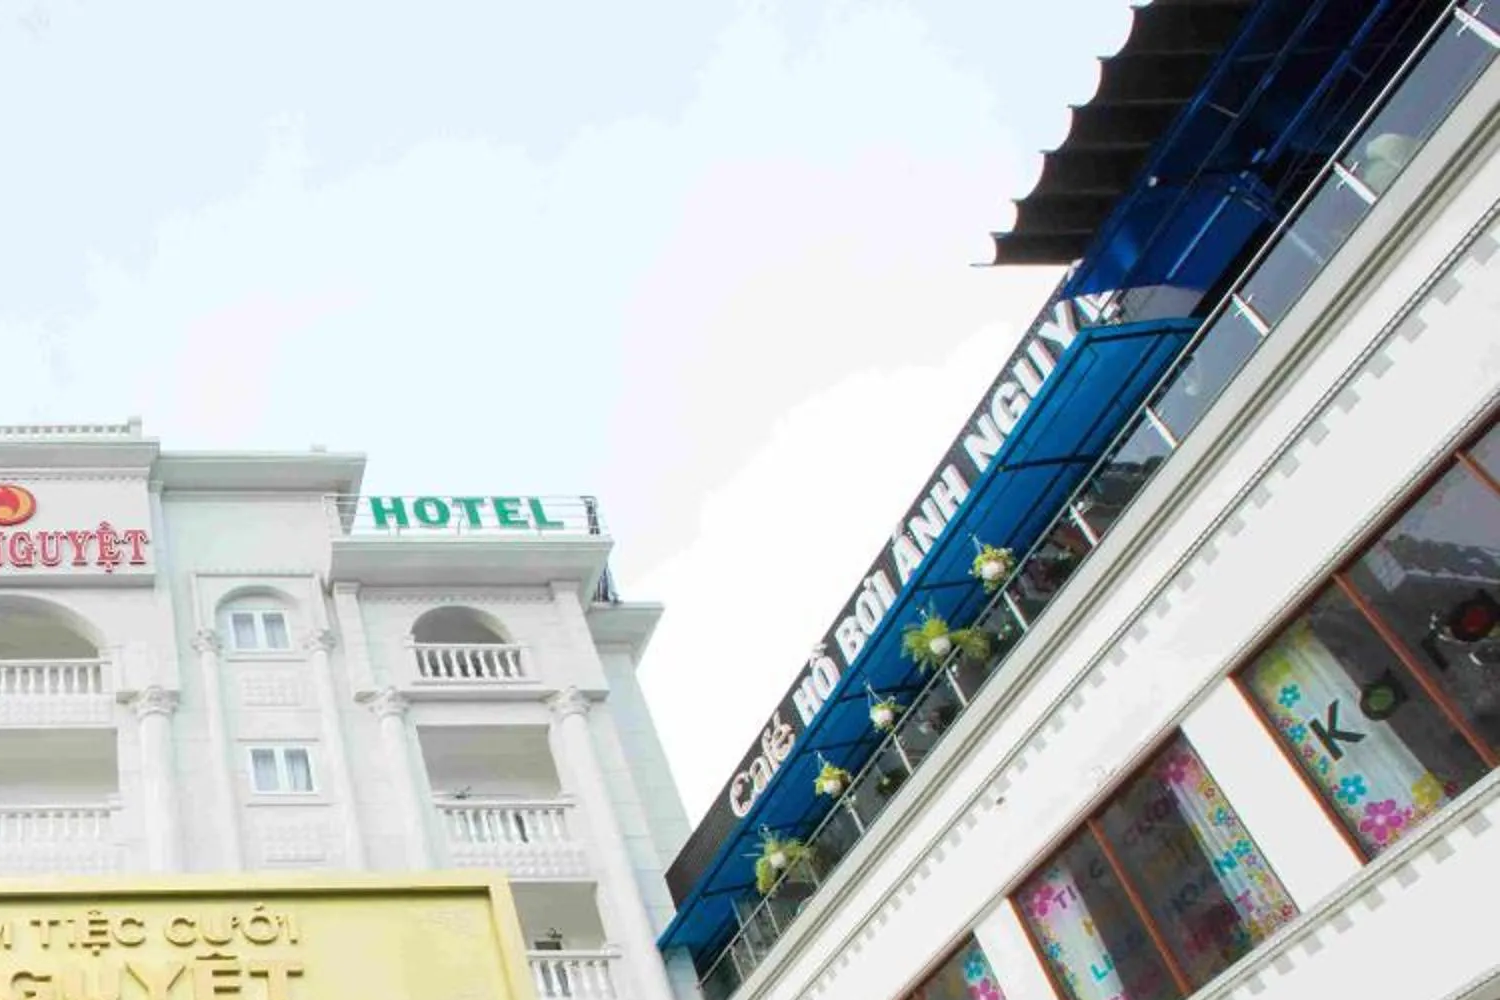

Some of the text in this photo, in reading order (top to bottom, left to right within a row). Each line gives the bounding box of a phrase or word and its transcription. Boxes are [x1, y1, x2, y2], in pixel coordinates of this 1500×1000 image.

[368, 496, 564, 530] HOTEL
[730, 710, 796, 818] Café
[835, 568, 898, 666] BƠI
[29, 909, 147, 957] TIỆC
[163, 905, 299, 947] CƯỚI
